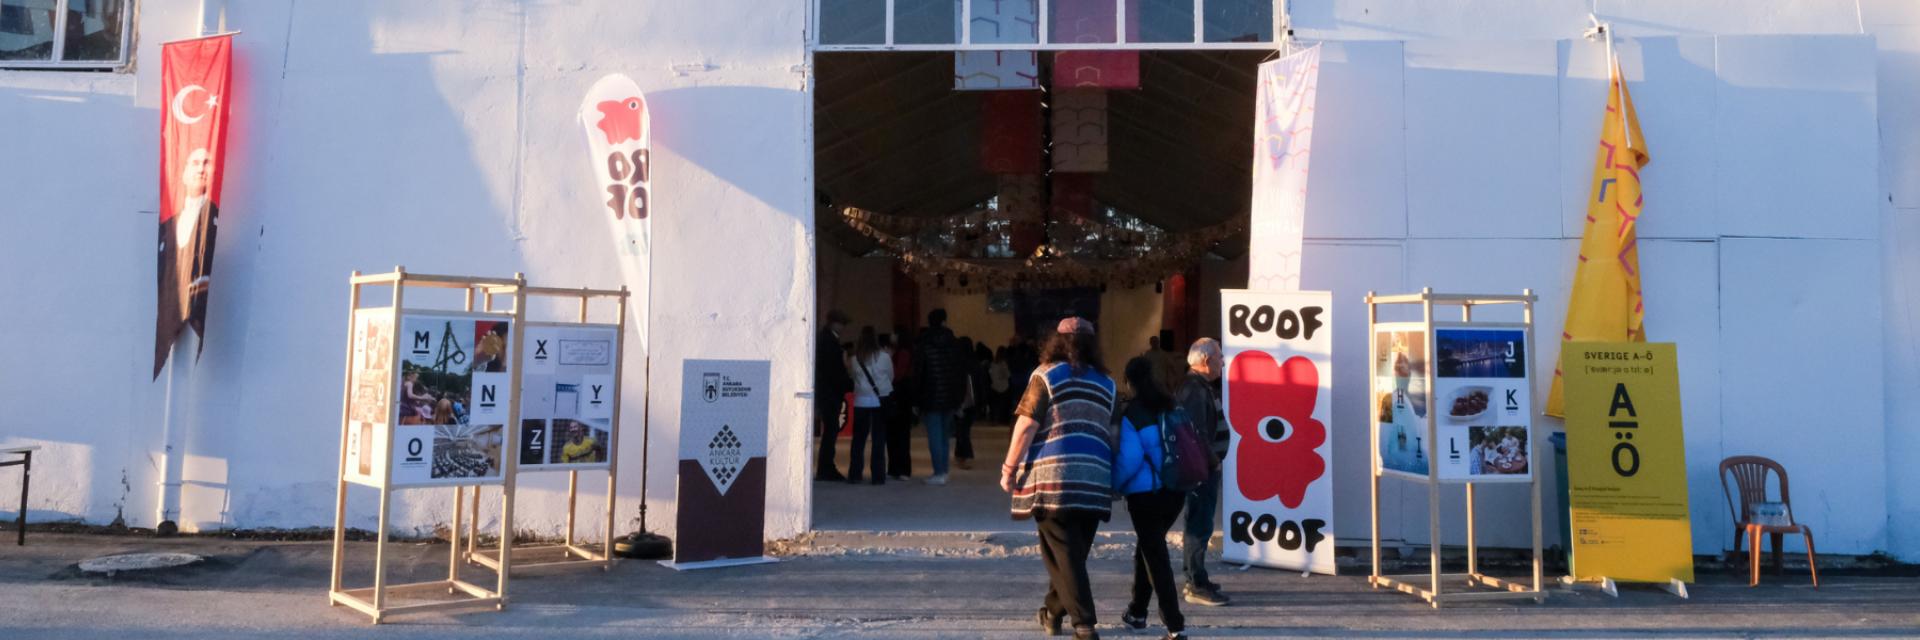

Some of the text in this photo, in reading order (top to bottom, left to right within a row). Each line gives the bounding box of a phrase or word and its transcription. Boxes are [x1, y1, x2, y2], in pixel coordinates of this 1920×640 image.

[1229, 304, 1323, 340] ROOF
[414, 331, 429, 349] M
[535, 340, 547, 355] X
[1505, 341, 1514, 358] J
[1584, 351, 1629, 361] SVERIGE
[481, 384, 496, 402] N
[591, 384, 603, 399] Y
[1506, 389, 1518, 405] K
[1609, 383, 1637, 417] A
[531, 429, 542, 445] Z
[1450, 437, 1460, 454] L
[407, 437, 423, 456] O
[709, 448, 741, 456] ANKARA
[1611, 431, 1640, 477] Ö
[1230, 510, 1326, 553] ROOF
